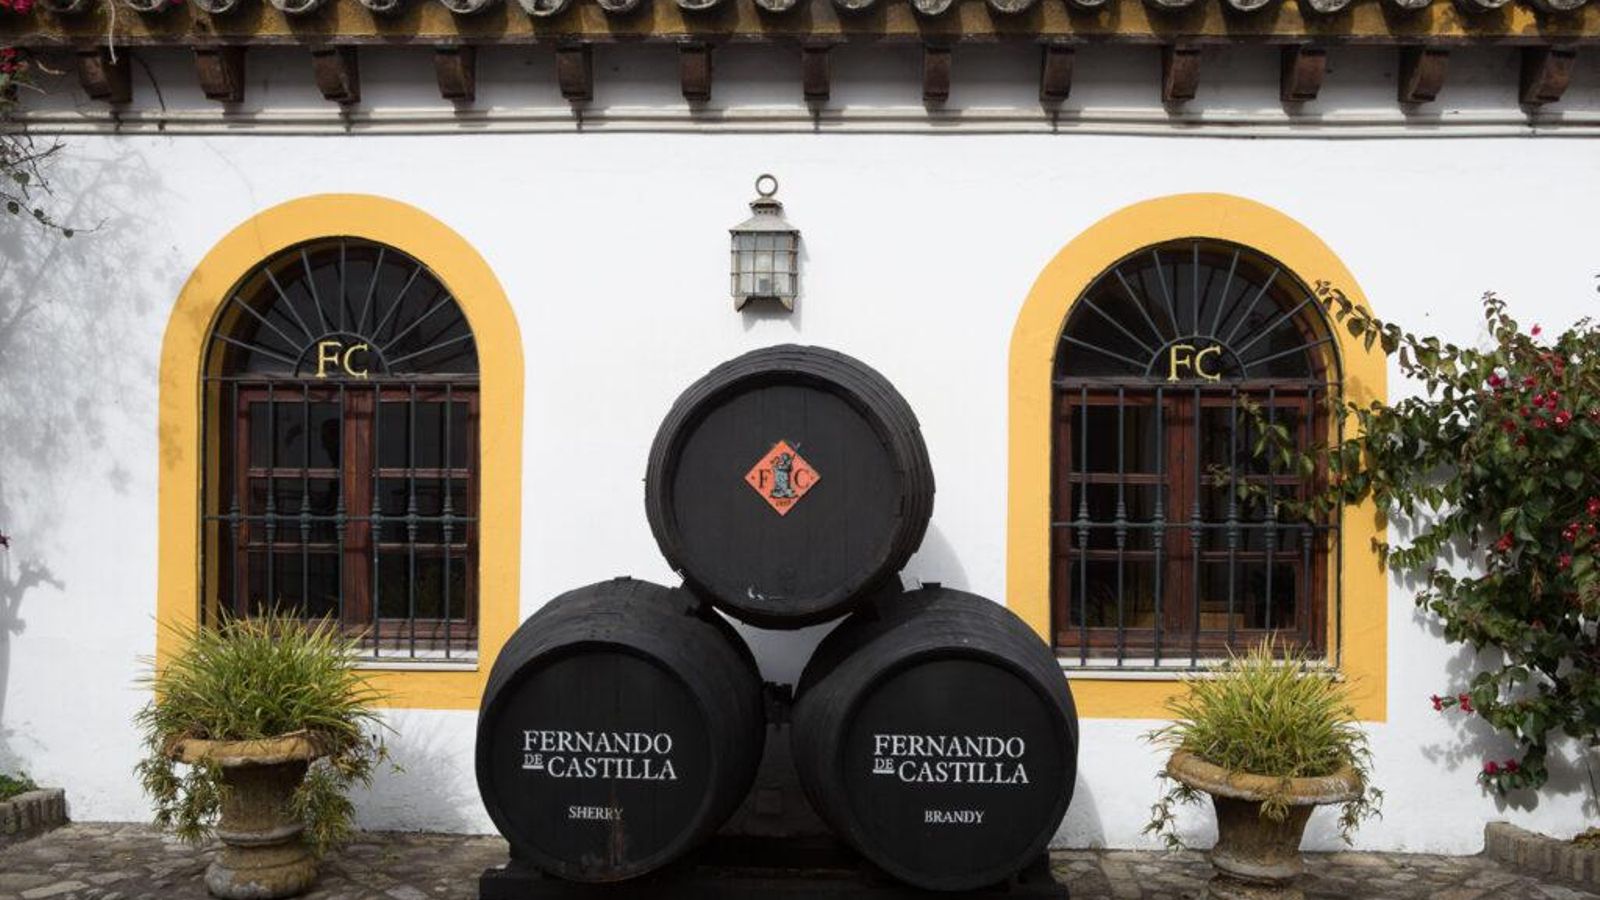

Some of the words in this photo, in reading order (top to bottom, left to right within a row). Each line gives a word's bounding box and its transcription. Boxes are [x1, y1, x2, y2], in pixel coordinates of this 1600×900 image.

[316, 341, 368, 379] FC
[1167, 344, 1221, 383] FC
[759, 469, 772, 488] F
[522, 730, 672, 754] FERNANDO
[873, 734, 1025, 758] FERNANDO
[522, 754, 544, 769] DE
[547, 756, 677, 779] CASTILLA
[873, 758, 895, 774] DE
[899, 761, 1029, 783] CASTILLA
[568, 805, 623, 820] SHERRY
[924, 810, 984, 823] BRANDY
